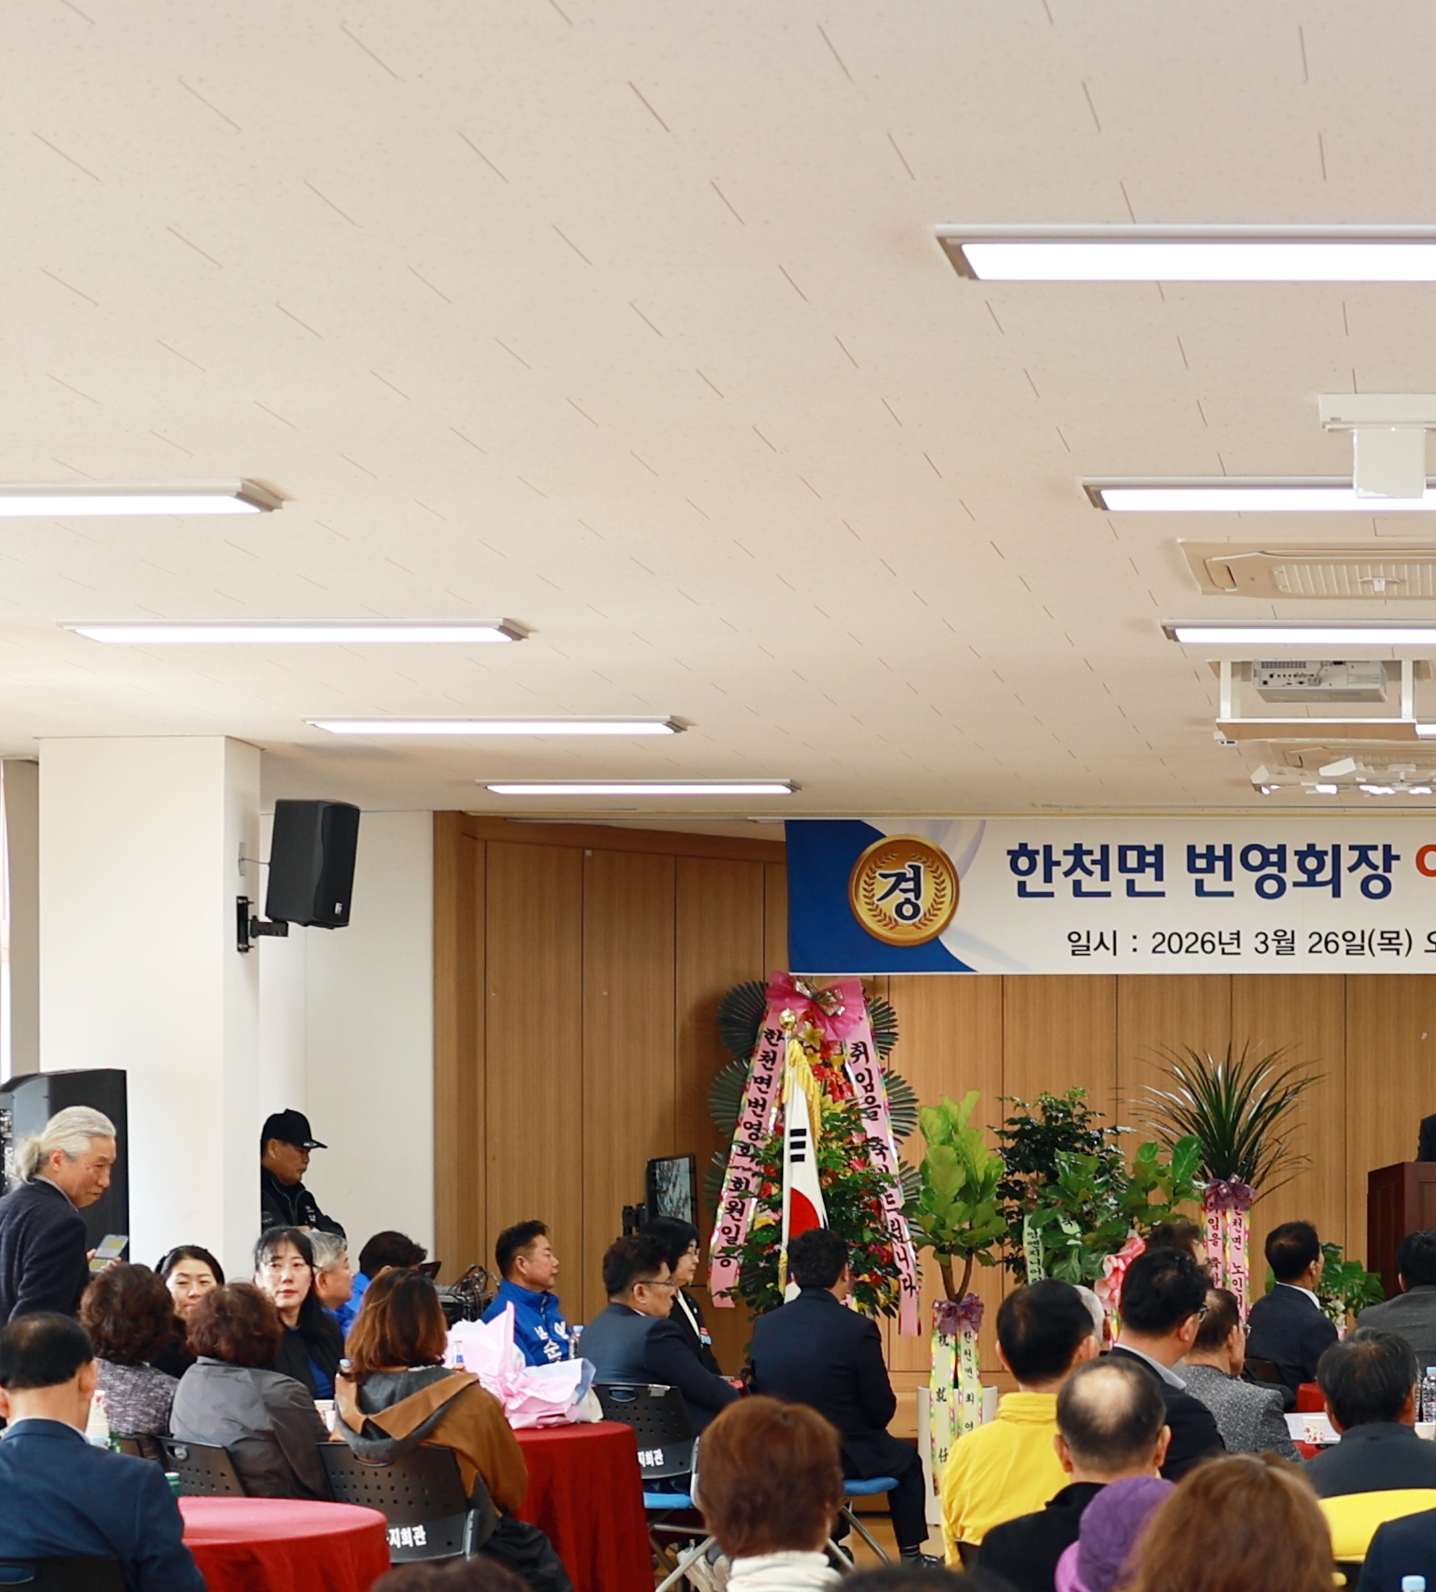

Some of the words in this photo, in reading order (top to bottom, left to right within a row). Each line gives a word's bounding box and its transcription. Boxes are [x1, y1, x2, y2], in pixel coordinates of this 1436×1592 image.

[876, 863, 923, 921] 경
[1006, 842, 1166, 900] 한천면
[1185, 842, 1402, 901] 번영회장
[1067, 929, 1118, 957] 일시
[1151, 929, 1242, 956] 2026년
[1254, 928, 1296, 956] 3월
[1307, 928, 1413, 958] 26일(목)
[849, 1041, 882, 1121] 취임을
